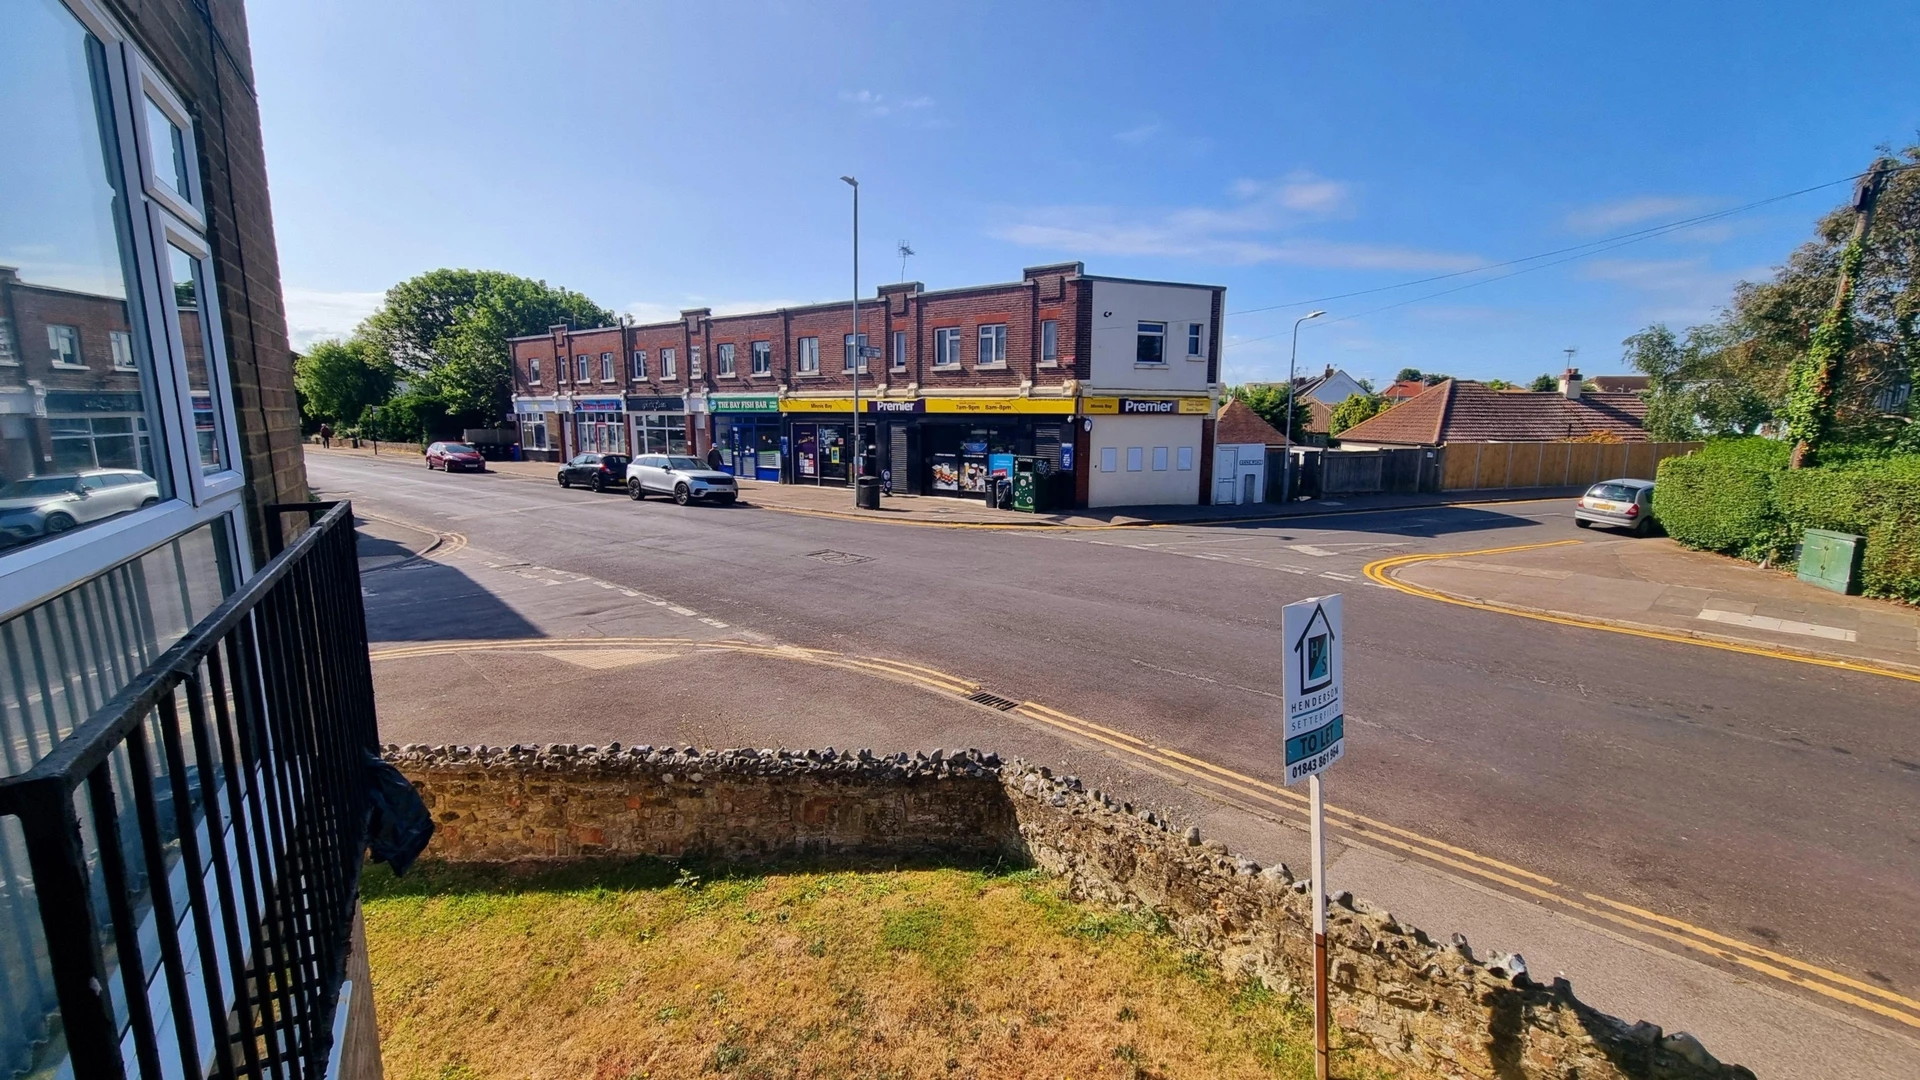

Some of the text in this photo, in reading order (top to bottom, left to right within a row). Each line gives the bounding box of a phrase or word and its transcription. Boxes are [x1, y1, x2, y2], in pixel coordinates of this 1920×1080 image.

[730, 401, 740, 409] BAY
[741, 401, 755, 409] FISH
[755, 401, 767, 409] BAR
[877, 401, 914, 411] Premier
[1125, 401, 1172, 412] Premier
[1311, 641, 1318, 658] H
[1322, 656, 1327, 672] S
[1291, 686, 1338, 713] HENDERSON
[1292, 703, 1338, 731] SETTERFIELD
[1300, 724, 1334, 755] TO LET
[1292, 744, 1339, 778] 01843 861 964
